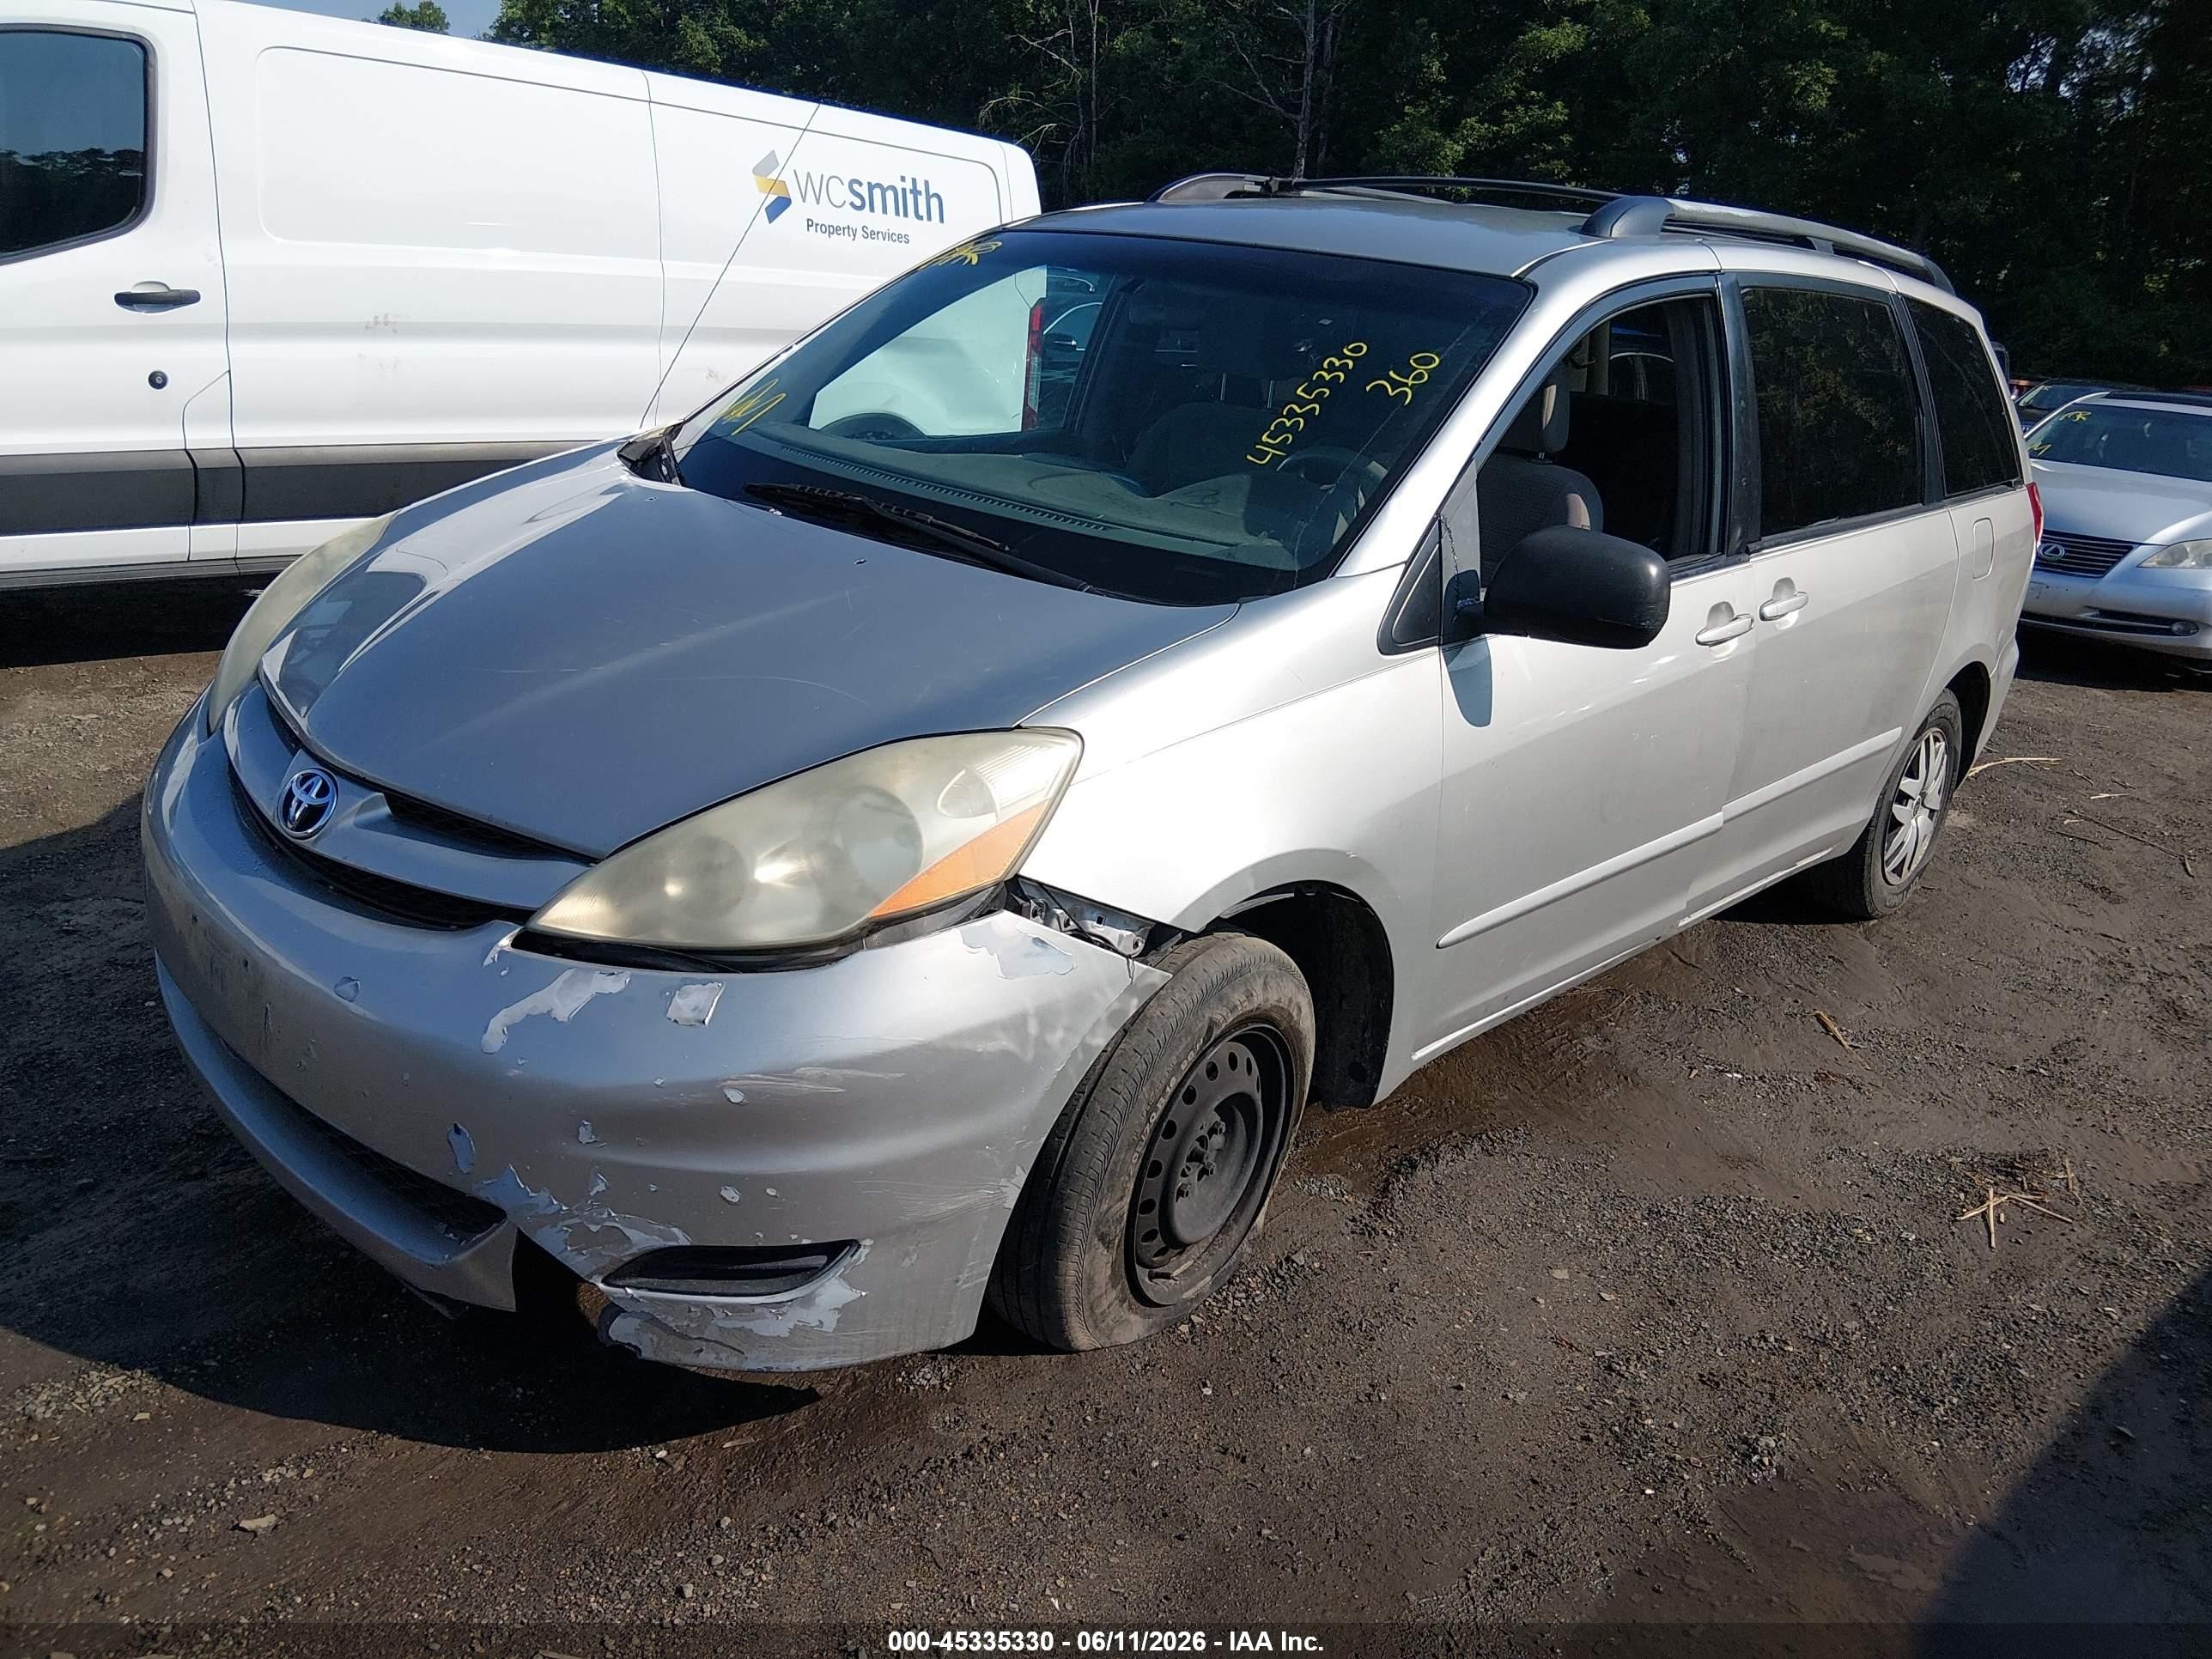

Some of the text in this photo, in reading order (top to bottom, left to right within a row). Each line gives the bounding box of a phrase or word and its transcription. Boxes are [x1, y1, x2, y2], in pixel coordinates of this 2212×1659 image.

[793, 168, 945, 225] WCsmith
[805, 217, 910, 245] Property Services
[1246, 342, 1368, 465] 45335330
[1365, 352, 1441, 406] 360
